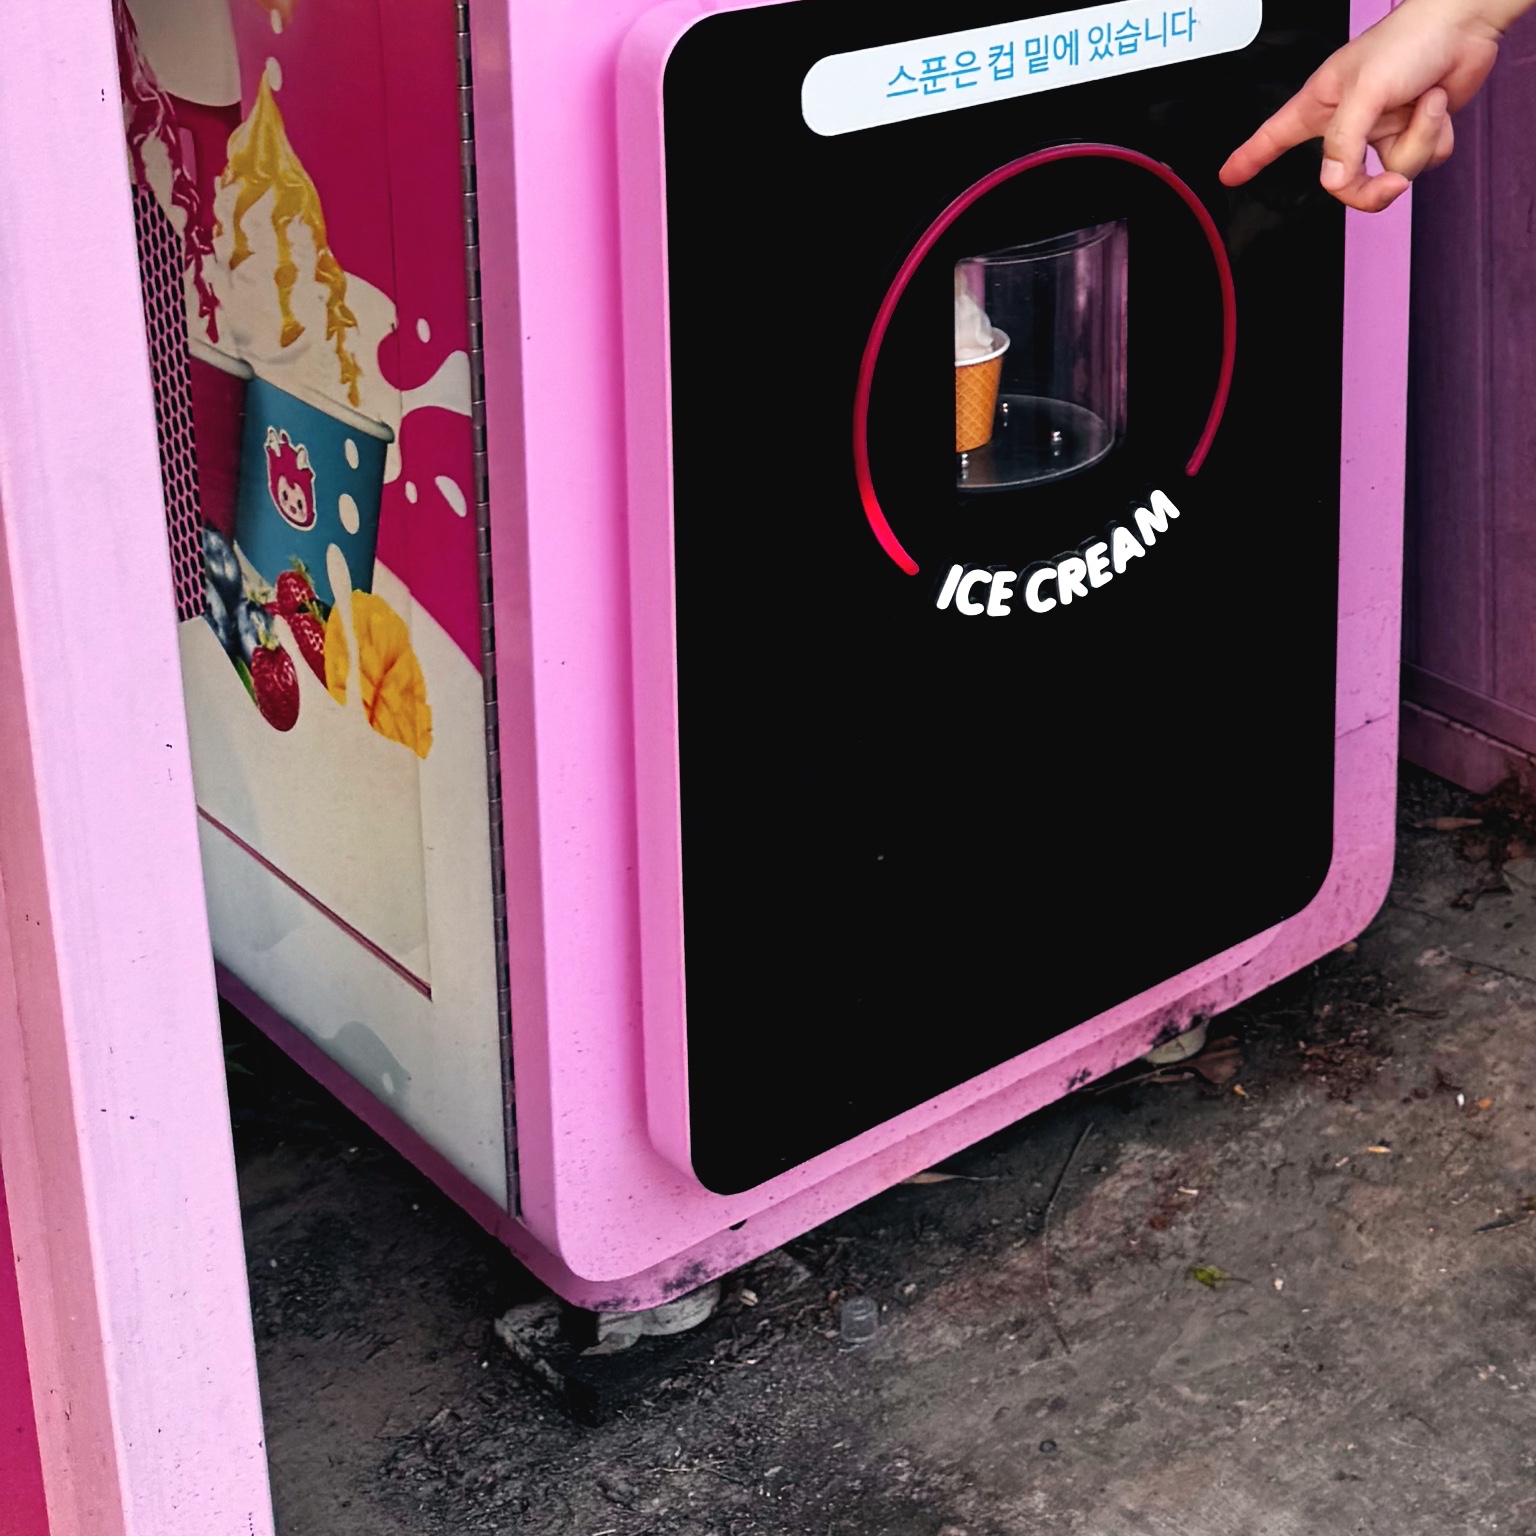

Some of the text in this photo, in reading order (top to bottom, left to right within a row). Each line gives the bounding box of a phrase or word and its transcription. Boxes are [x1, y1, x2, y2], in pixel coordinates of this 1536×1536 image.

[886, 7, 1197, 98] 스푼은 컵 밑에 있습니다
[936, 489, 1181, 617] ICE CREAM
